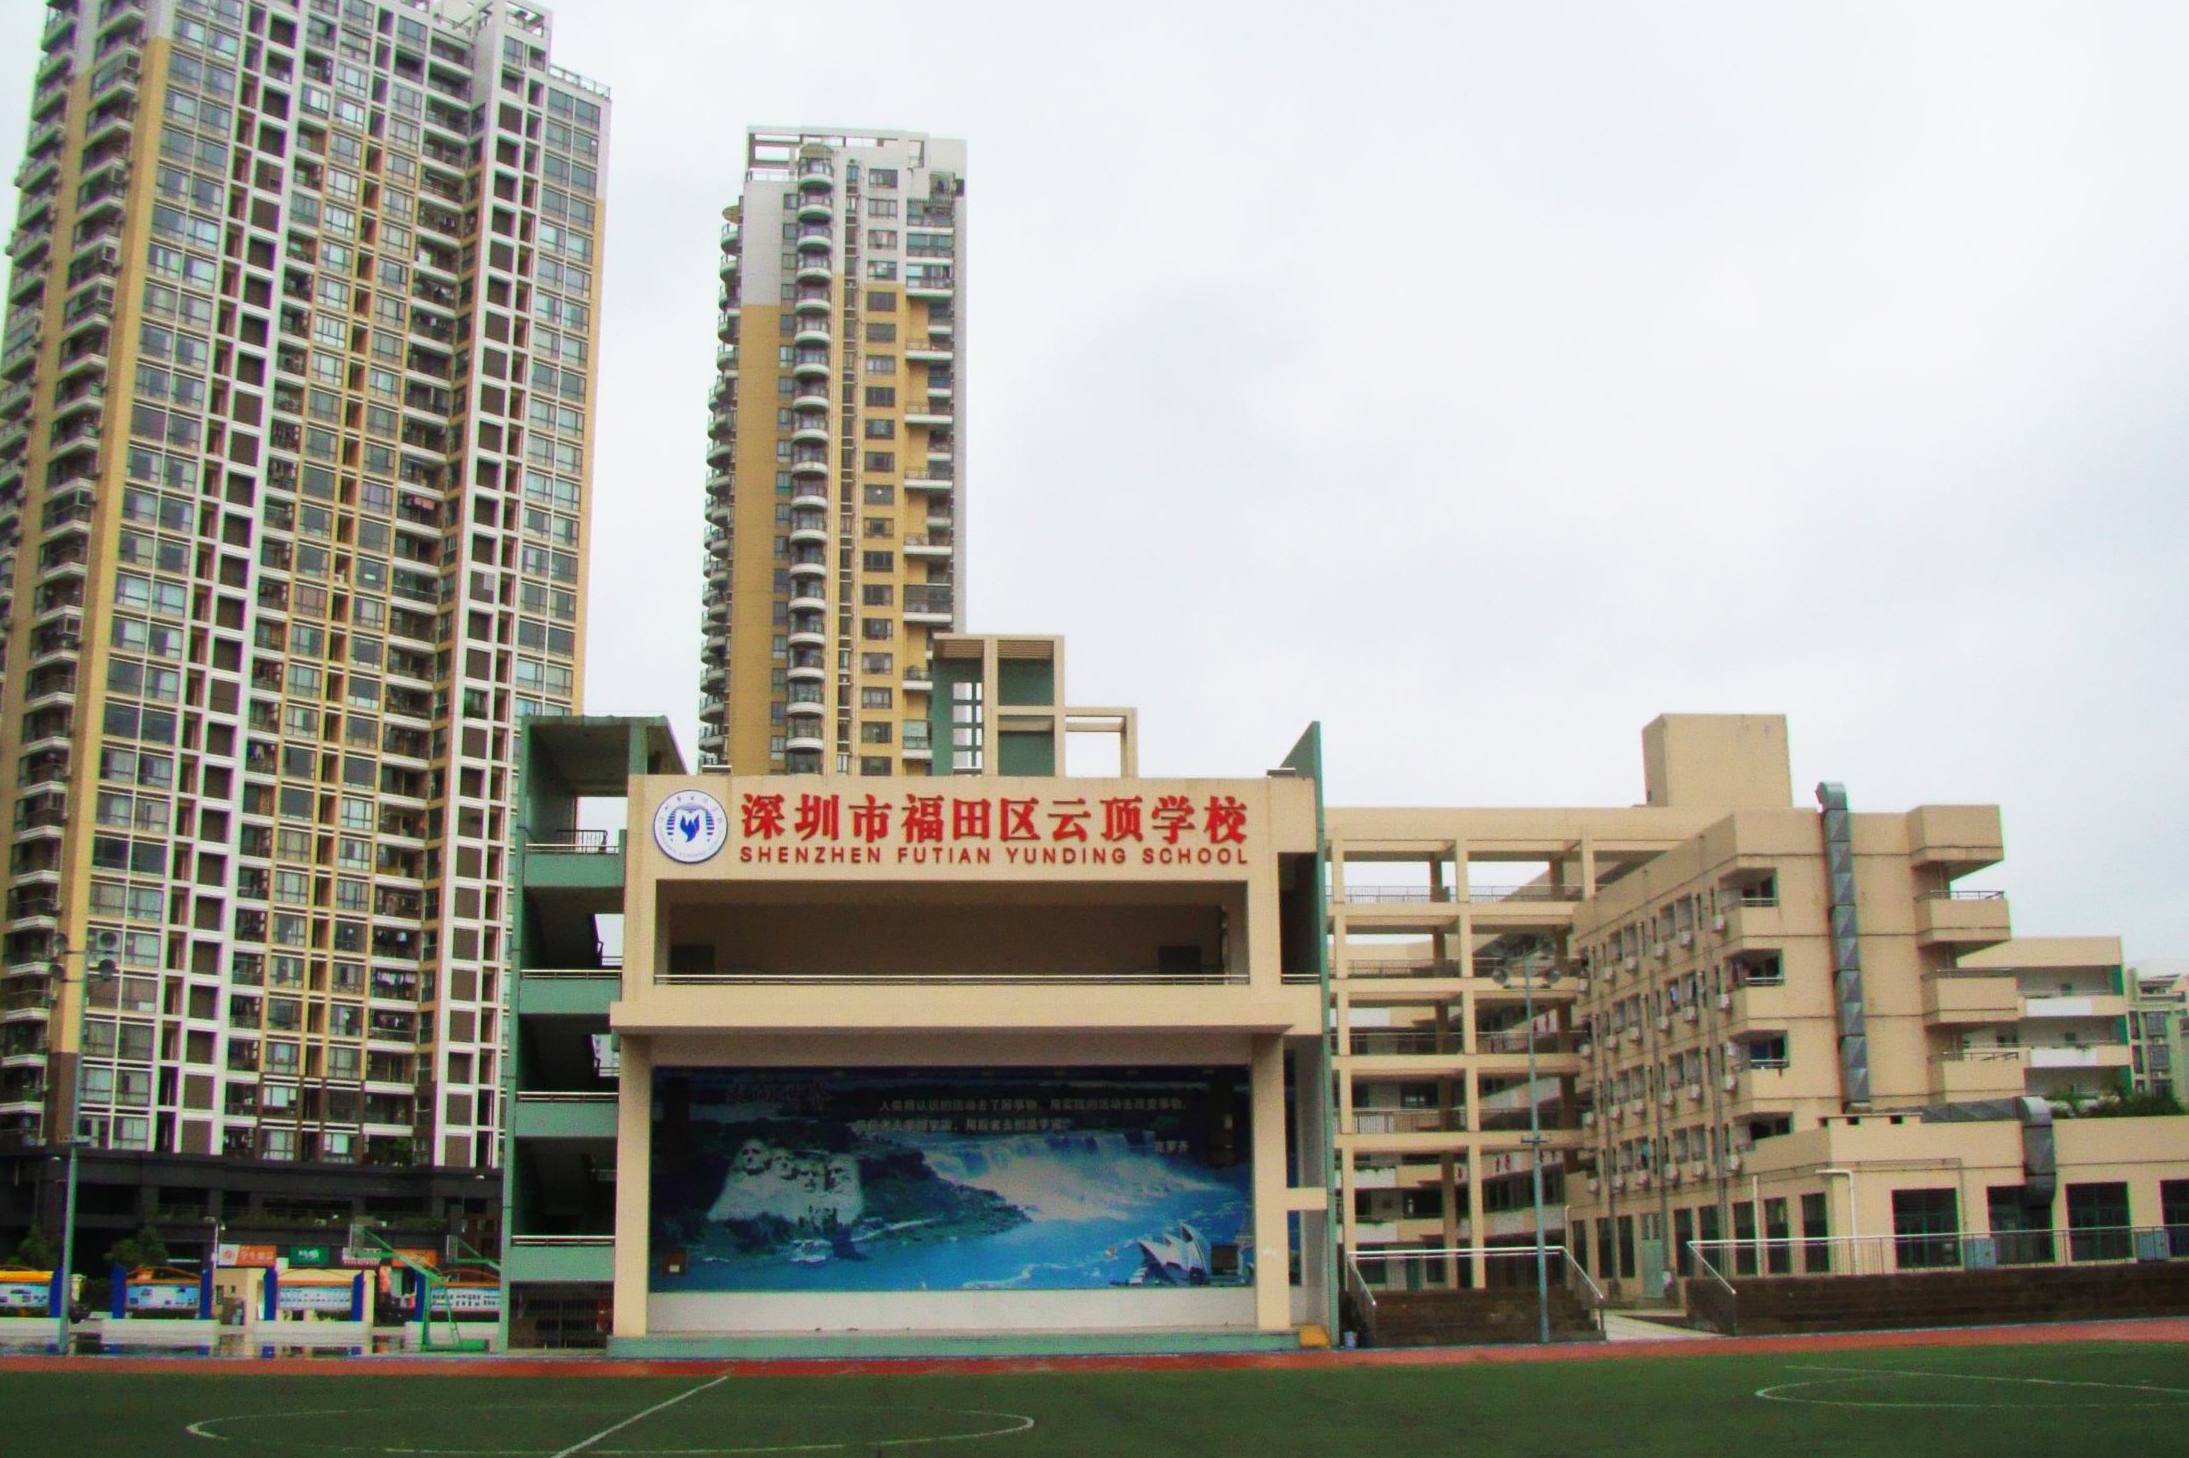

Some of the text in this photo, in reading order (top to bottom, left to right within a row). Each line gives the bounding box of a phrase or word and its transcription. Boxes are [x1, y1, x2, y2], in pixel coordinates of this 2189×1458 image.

[741, 793, 1247, 844] 深圳市福田区云顶学校
[740, 846, 1248, 865] SHENZHEN FUTIAN YUNDING SCHOOL
